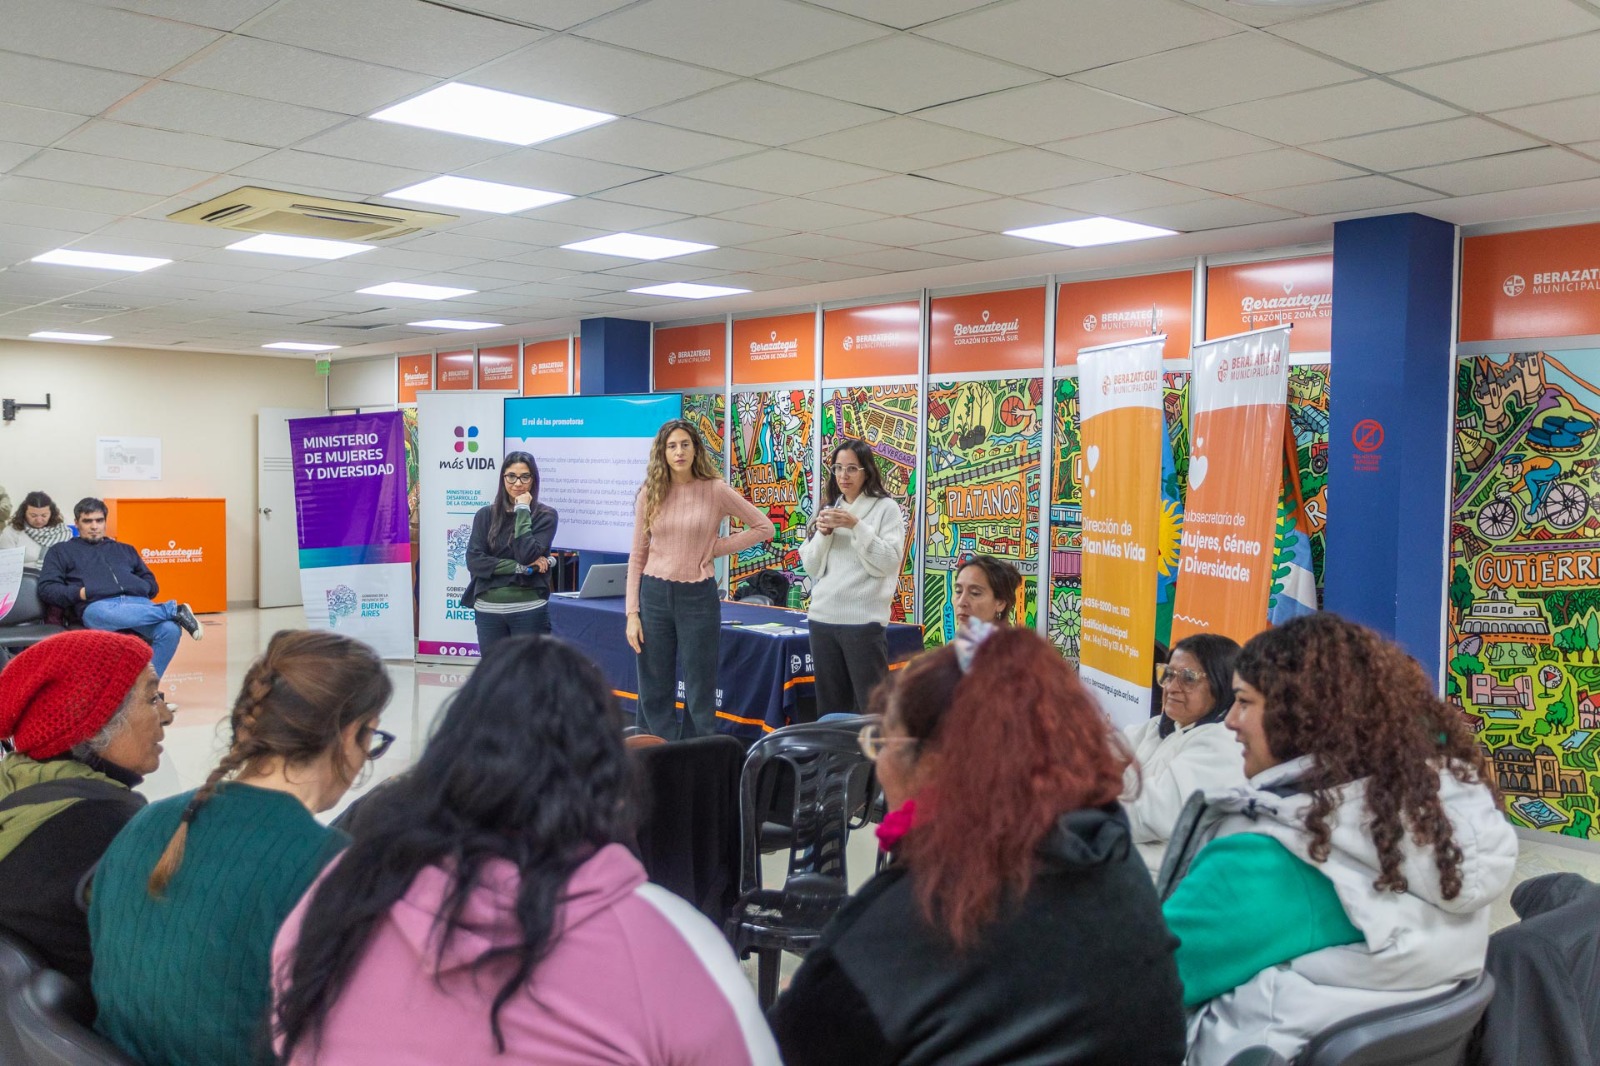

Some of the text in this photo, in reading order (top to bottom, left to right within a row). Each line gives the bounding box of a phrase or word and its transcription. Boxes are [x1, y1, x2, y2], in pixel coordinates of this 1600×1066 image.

[1533, 268, 1600, 284] BERAZAT
[1294, 310, 1317, 319] ZONA
[954, 318, 1019, 336] Berazategui
[750, 338, 798, 352] Berazategui
[954, 337, 980, 346] CORAZÓN
[678, 349, 710, 358] BERAZATEGUI
[1114, 370, 1158, 384] BERAZATEGUI
[536, 418, 543, 426] de
[552, 418, 584, 427] promotoras
[304, 433, 378, 449] MINISTERIO
[304, 448, 384, 464] DE MUJERES
[440, 457, 496, 470] más VIDA
[305, 463, 394, 480] Y DIVERSIDAD
[754, 481, 796, 503] ESPAÑA
[948, 486, 1020, 518] PLÁTANOS
[1082, 516, 1132, 536] Dirección de
[1233, 512, 1245, 526] de
[141, 546, 202, 559] Berazategui
[1082, 536, 1146, 562] Plan Más Vida
[1223, 533, 1260, 556] Género
[1184, 556, 1250, 582] Diversidades
[446, 610, 475, 620] AIRES
[1084, 618, 1128, 640] Edificio Municipal
